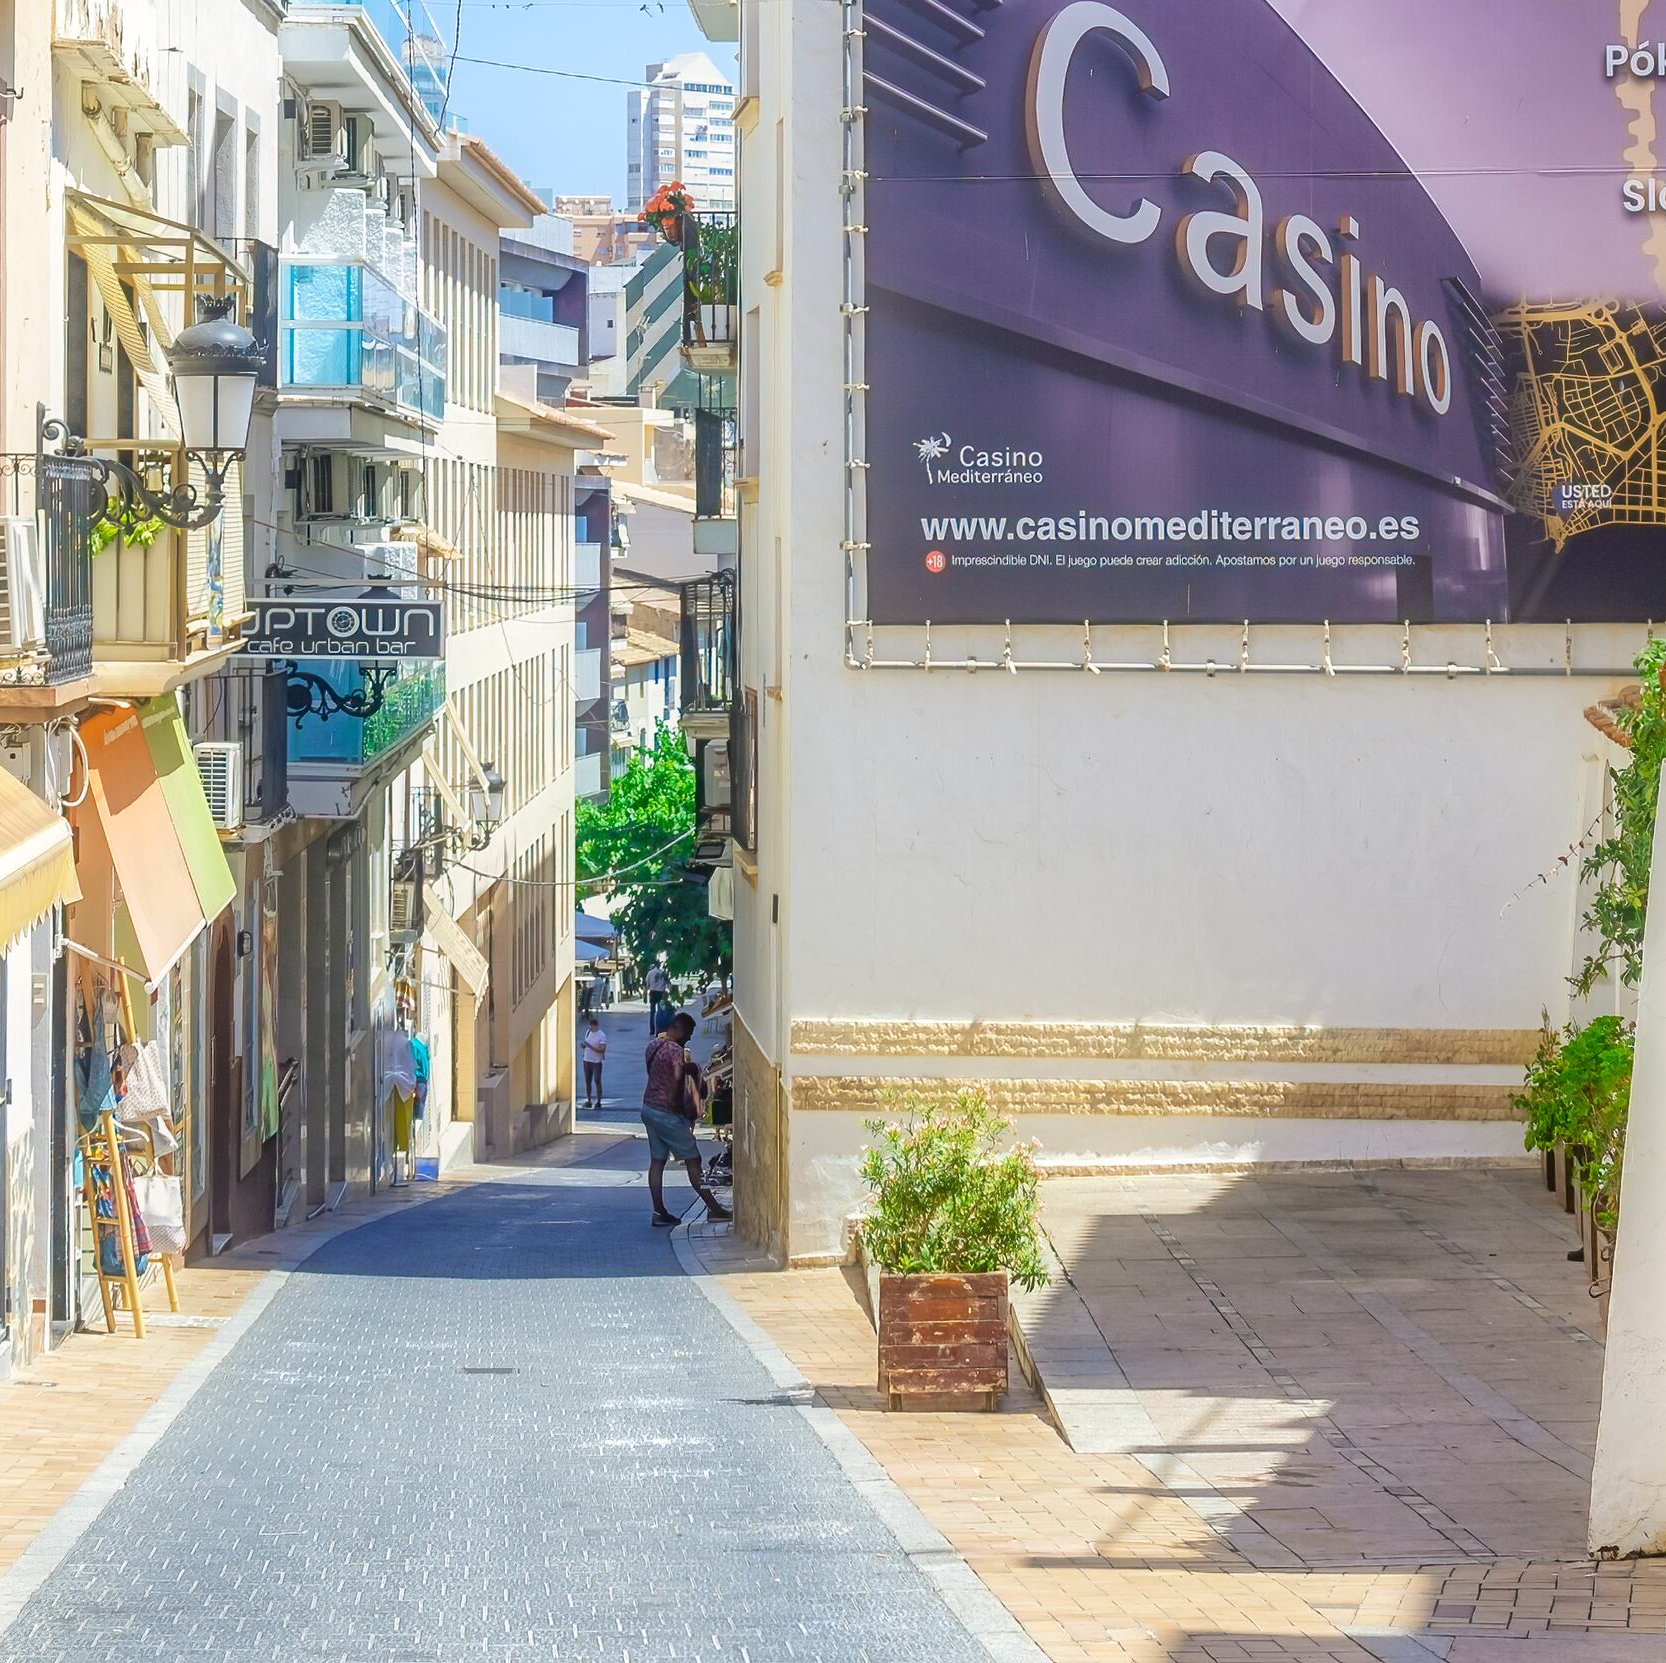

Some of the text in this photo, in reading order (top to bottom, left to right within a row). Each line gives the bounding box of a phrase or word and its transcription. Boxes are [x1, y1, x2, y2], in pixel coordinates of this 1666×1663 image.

[1026, 0, 1450, 416] Casino
[959, 445, 1043, 467] Casino
[937, 469, 1043, 484] Mediterráneo
[1561, 484, 1612, 498] USTED
[921, 509, 1420, 541] www.casinomediterraneo.es
[951, 554, 1027, 567] Imprescindible
[1030, 555, 1053, 566] DNI.
[1055, 554, 1066, 566] El
[1068, 555, 1098, 568] juego
[1100, 555, 1134, 568] puede
[1136, 556, 1163, 566] crear
[1165, 554, 1213, 566] adicción.
[1215, 554, 1276, 567] Apostamos
[1279, 556, 1297, 567] por
[1299, 557, 1313, 566] un
[1315, 555, 1346, 568] juego
[1348, 554, 1416, 568] responsable.
[247, 637, 416, 655] cafe urban bar
